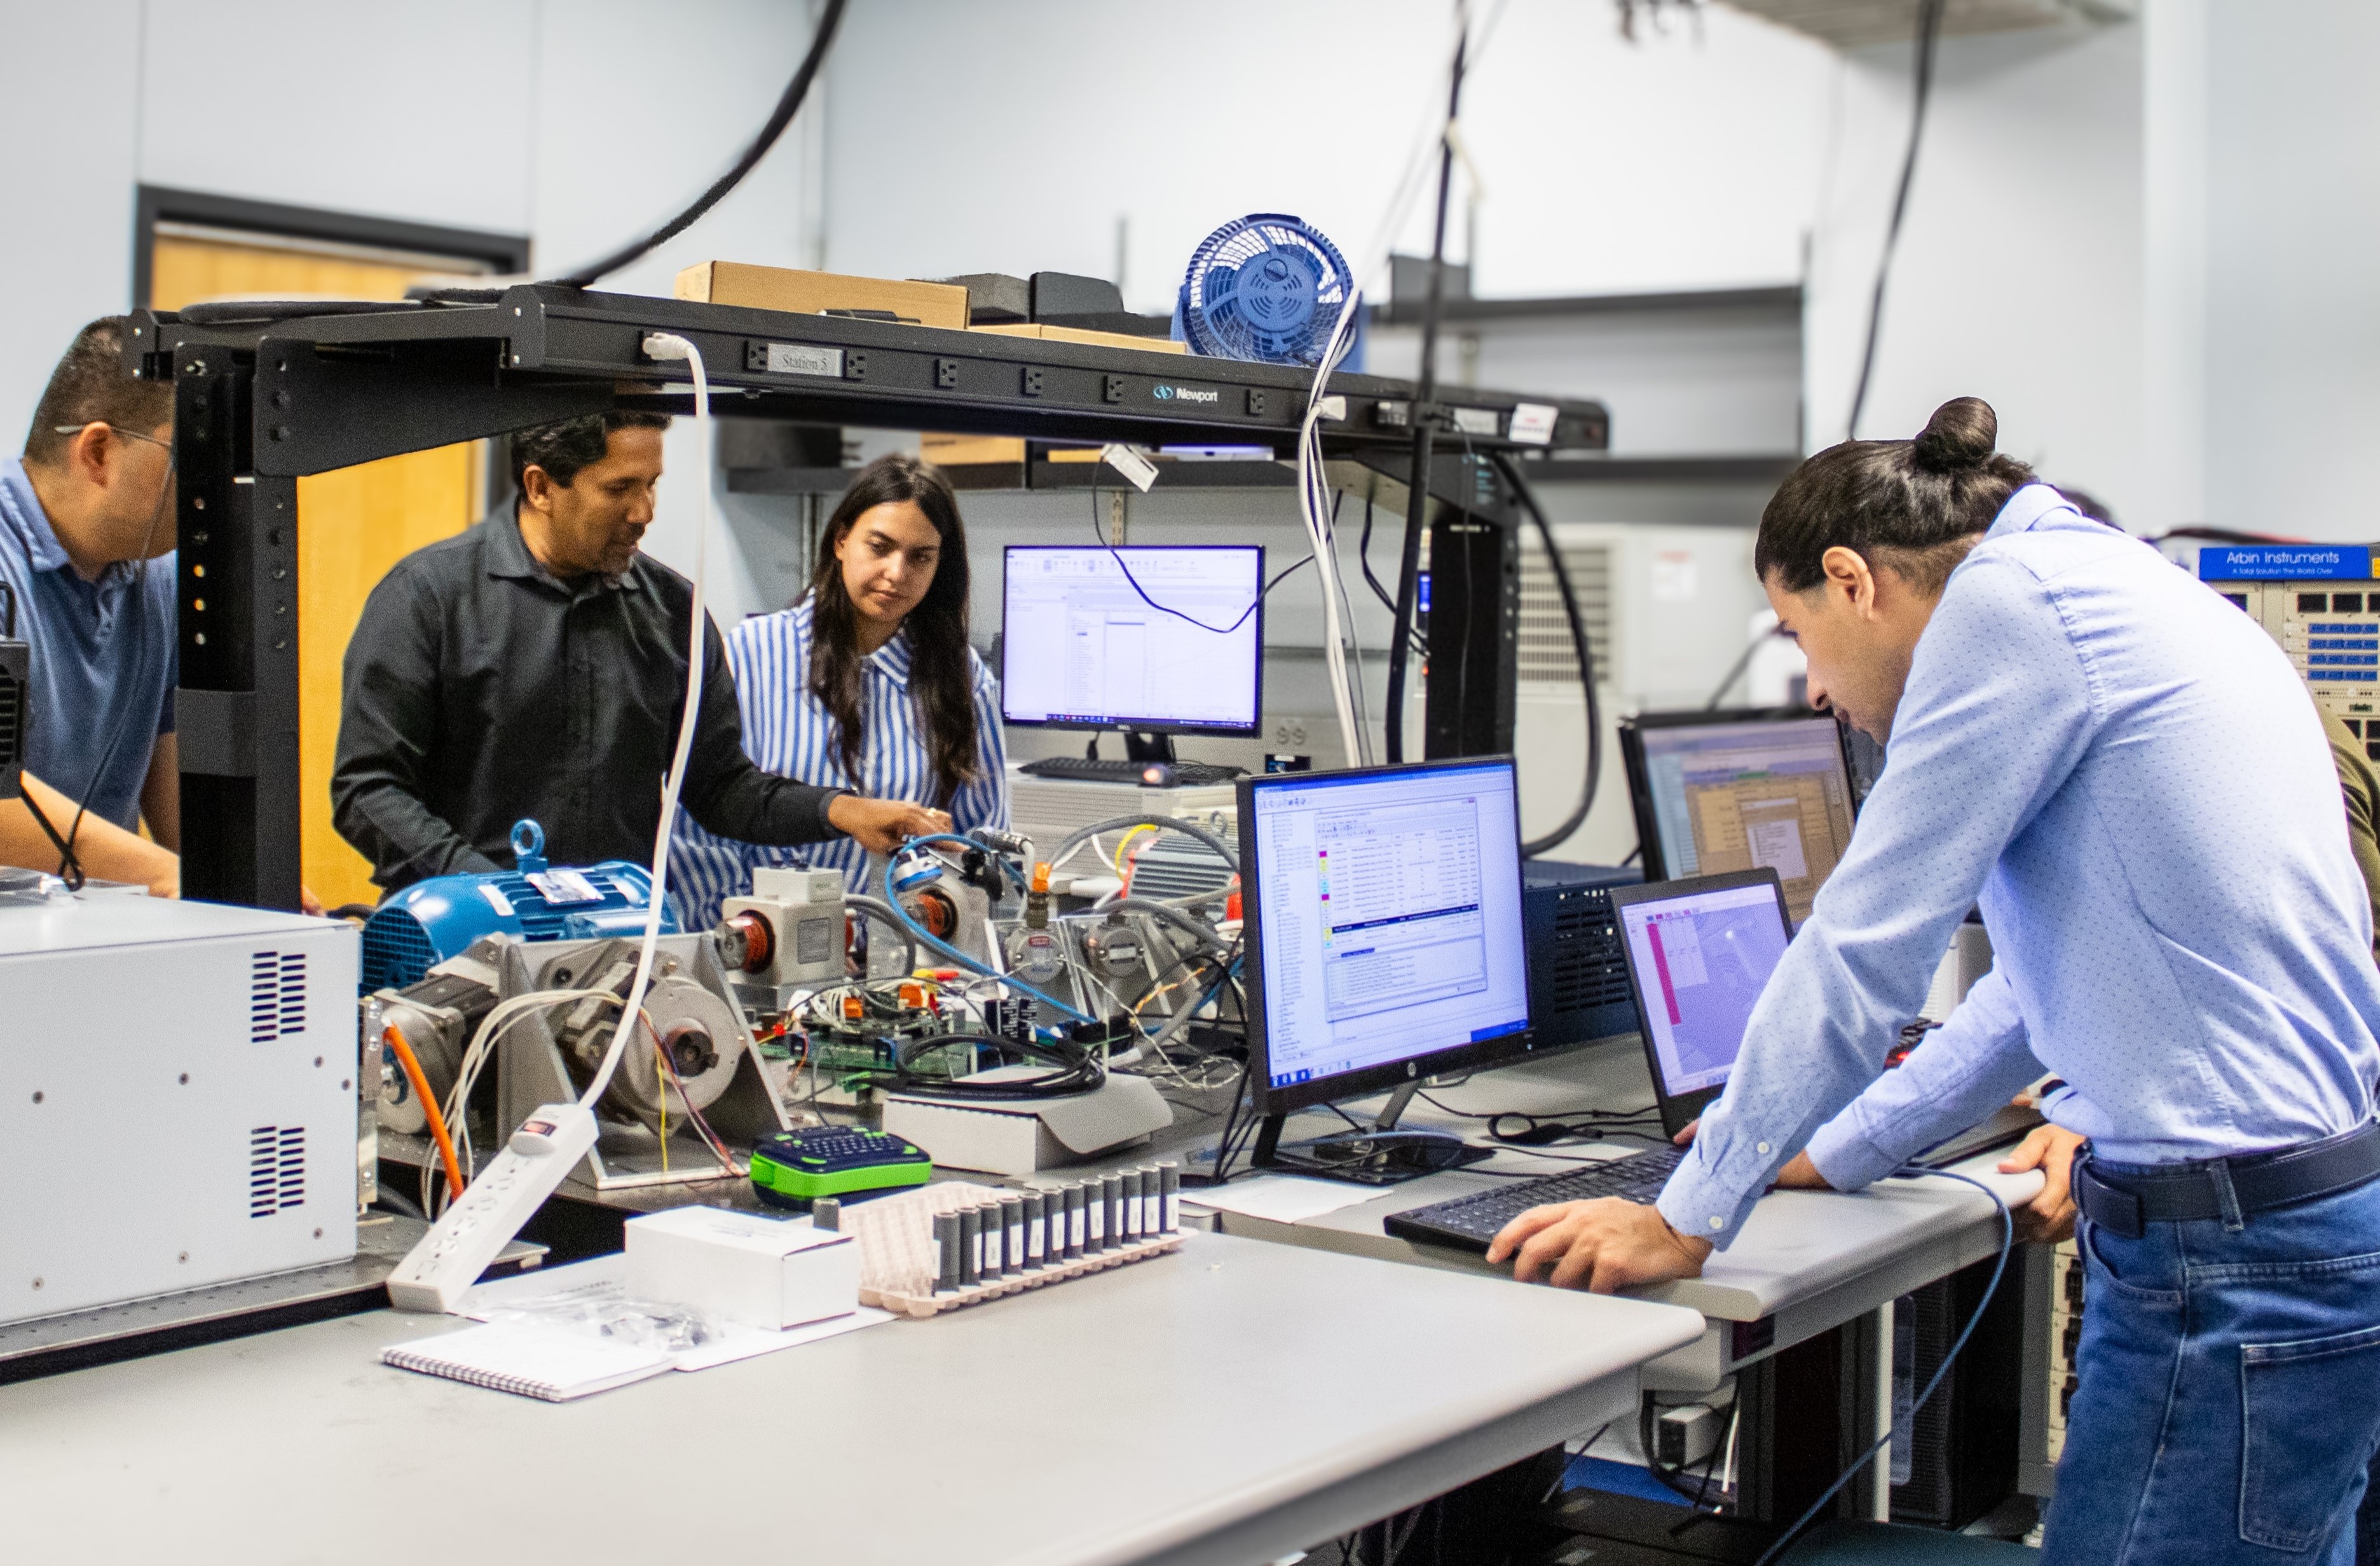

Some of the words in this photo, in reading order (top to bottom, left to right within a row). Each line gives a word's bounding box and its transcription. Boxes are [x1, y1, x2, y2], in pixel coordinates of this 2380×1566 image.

[783, 354, 818, 370] Station
[821, 357, 828, 371] 5
[1176, 387, 1218, 403] Newport
[2226, 552, 2260, 564] Arbin
[2264, 552, 2340, 564] Instruments
